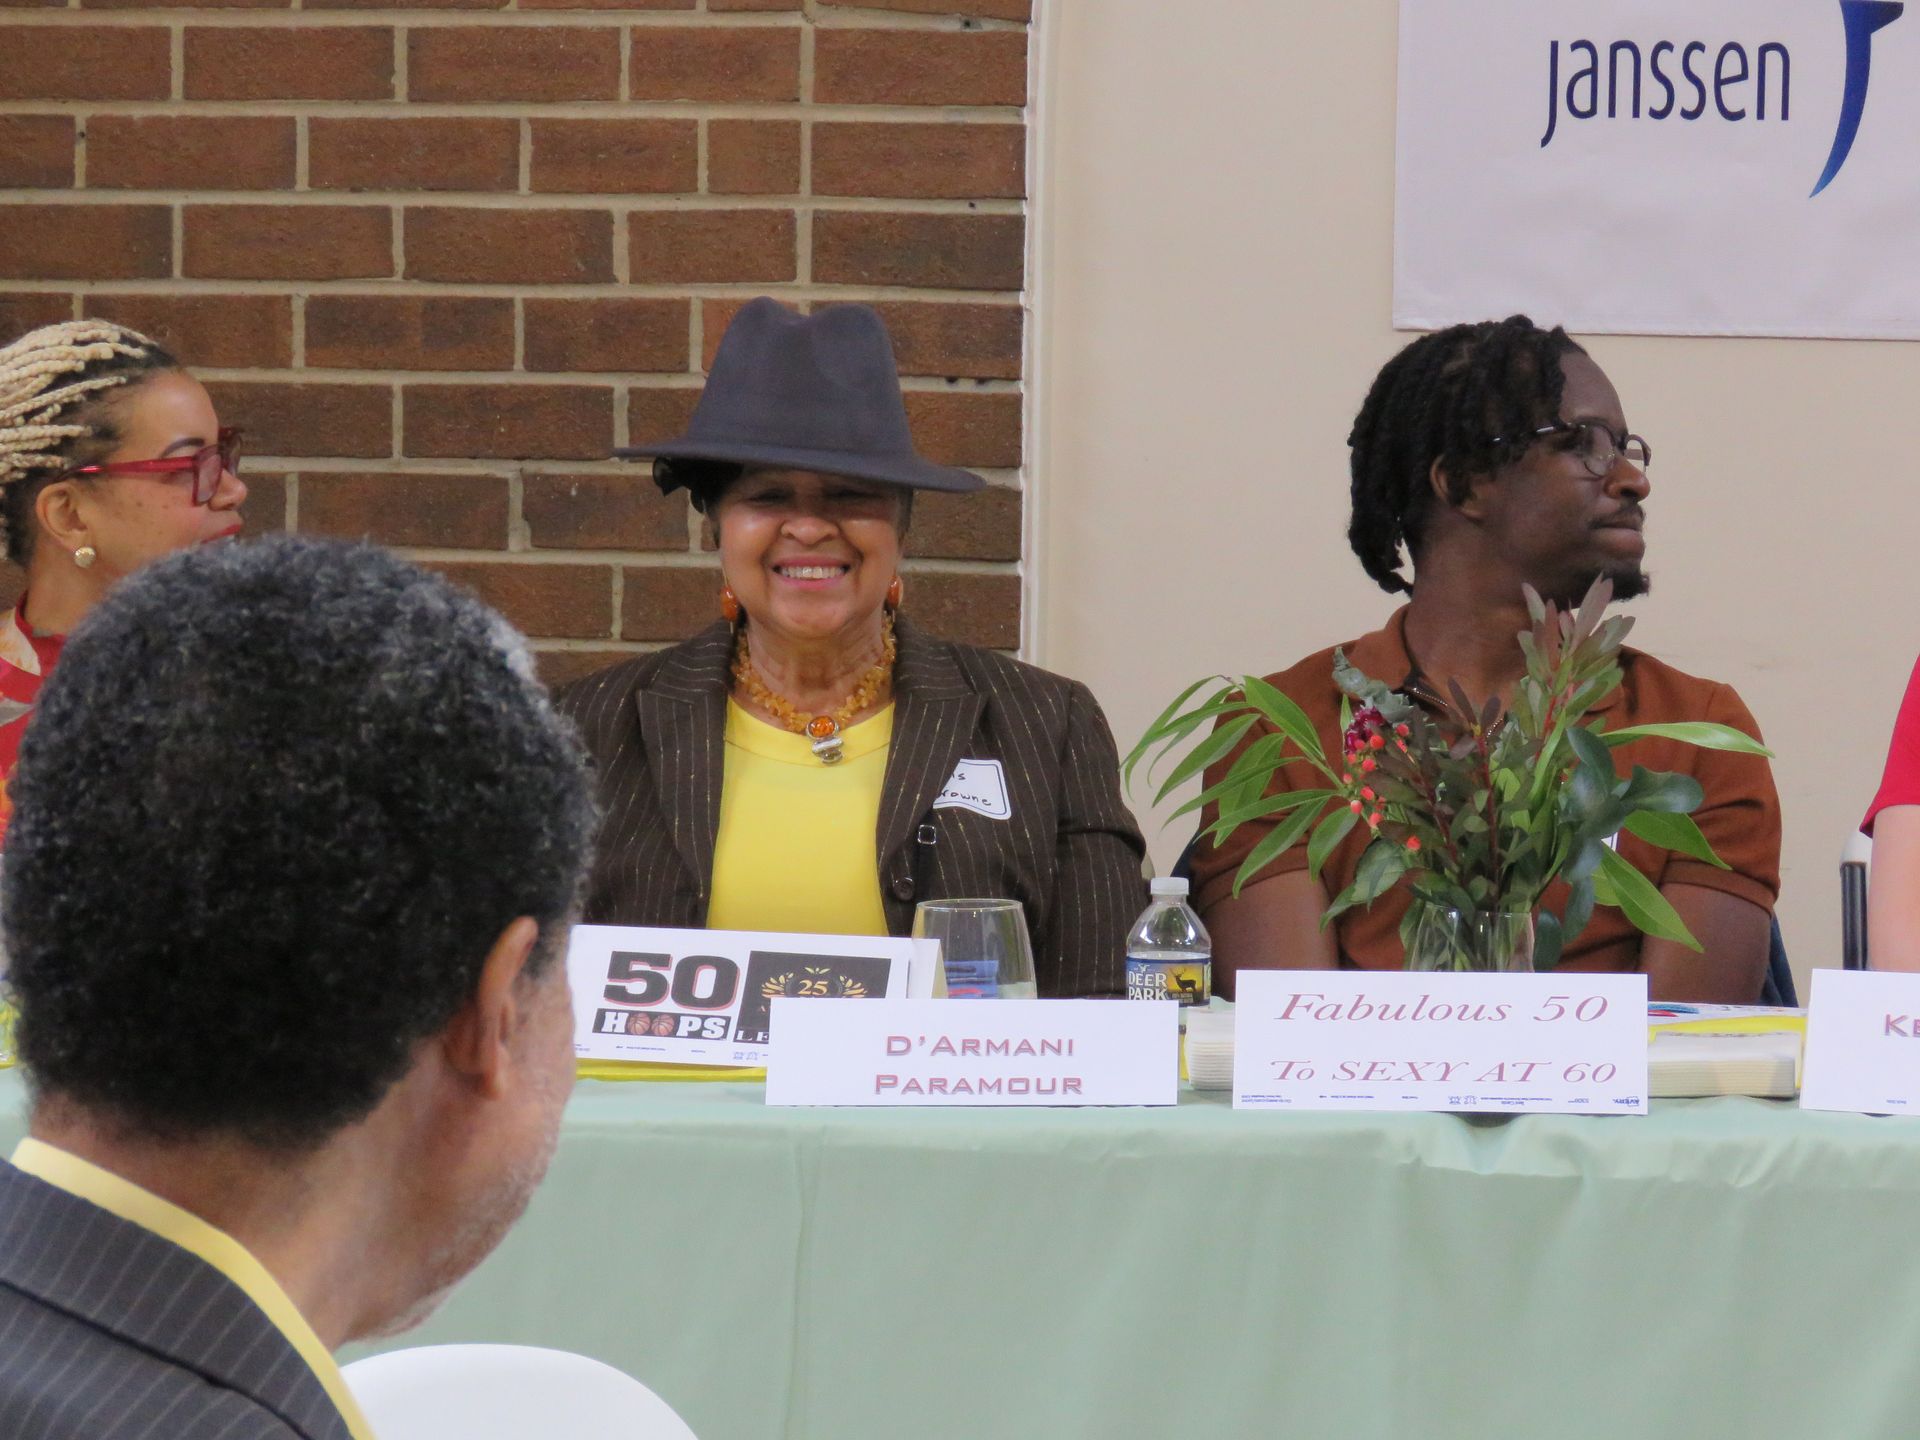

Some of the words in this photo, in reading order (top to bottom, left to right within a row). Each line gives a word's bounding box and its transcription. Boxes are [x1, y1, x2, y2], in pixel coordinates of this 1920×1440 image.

[1540, 39, 1791, 149] janssen
[941, 789, 992, 806] rowne
[603, 950, 741, 1011] 50
[797, 979, 829, 996] 25
[1128, 970, 1167, 987] DEER
[1128, 986, 1168, 1000] PARK
[1273, 993, 1513, 1021] Fabulous
[1533, 995, 1609, 1022] 50
[600, 1010, 727, 1041] HOOPS
[1270, 1060, 1316, 1081] To
[1331, 1060, 1470, 1082] SEXY
[1472, 1061, 1553, 1083] AT
[1563, 1062, 1617, 1083] 60
[875, 1074, 1083, 1095] PARAMOUR
